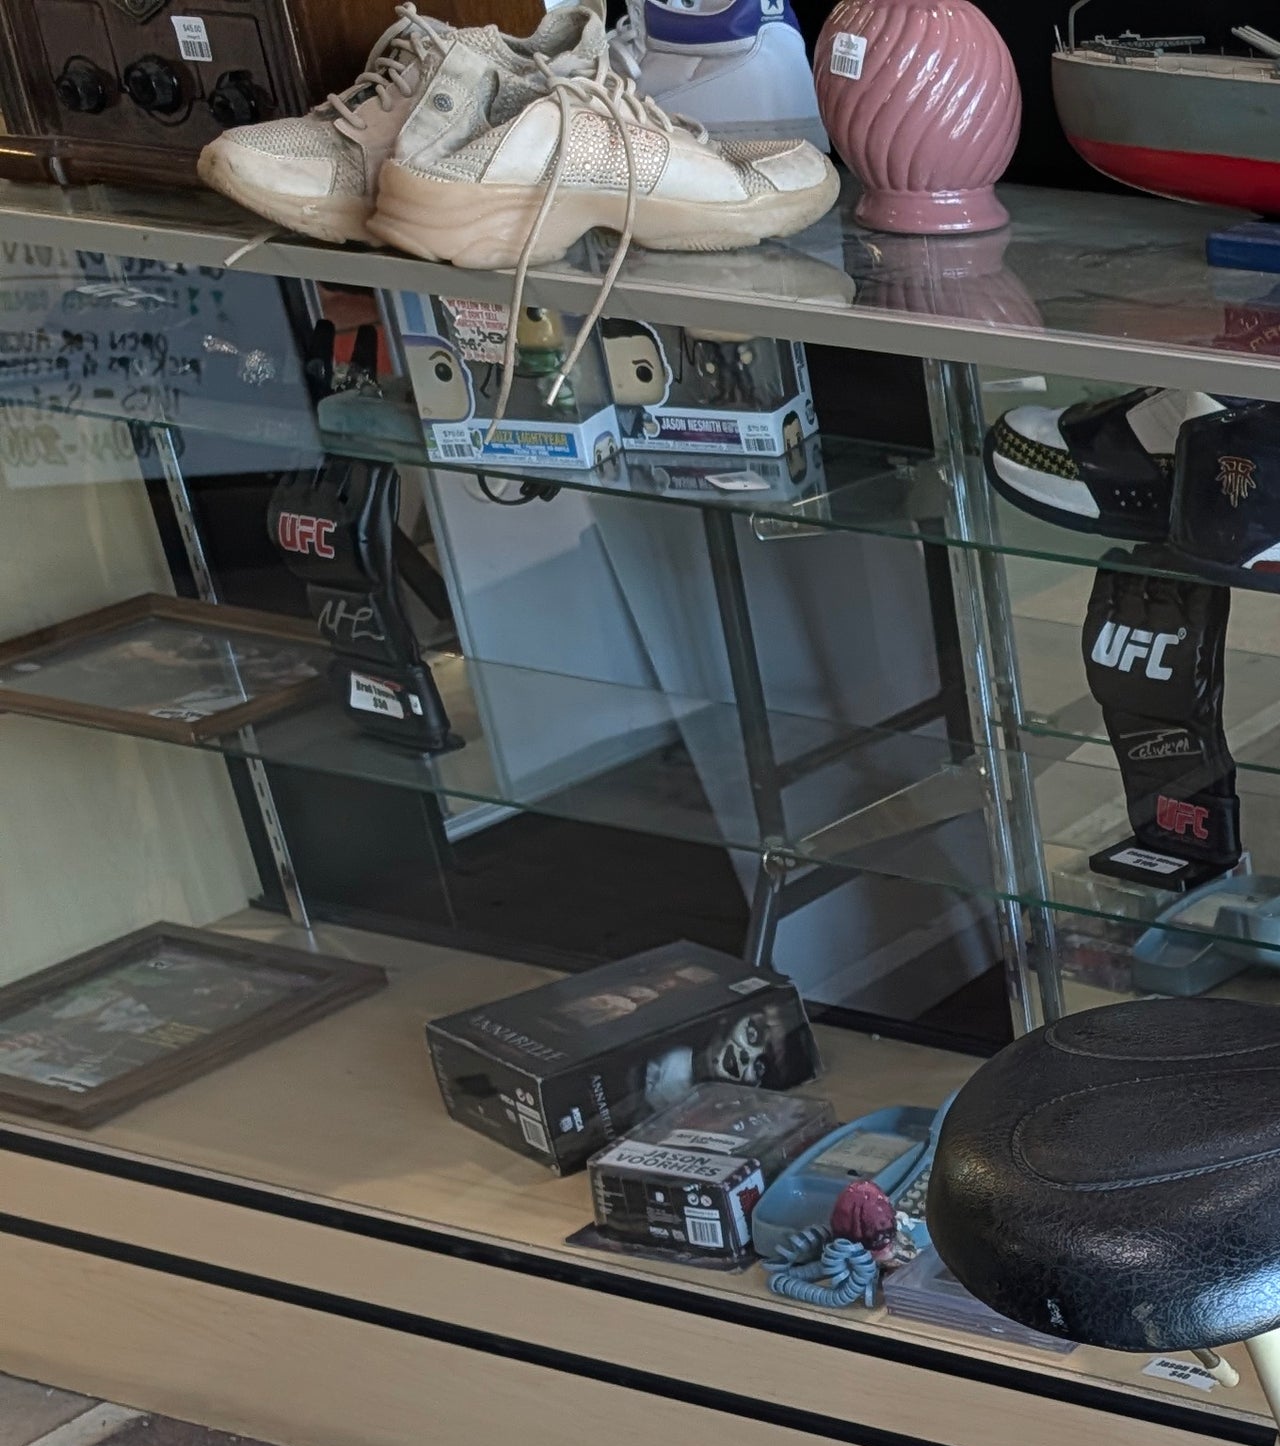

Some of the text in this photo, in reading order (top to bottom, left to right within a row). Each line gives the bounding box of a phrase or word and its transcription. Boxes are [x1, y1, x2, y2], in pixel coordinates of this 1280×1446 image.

[661, 416, 688, 432] JASON
[688, 418, 722, 434] NESMITH
[516, 432, 568, 447] LIGHTYEAR
[278, 511, 336, 560] UFC
[1091, 621, 1180, 681] UFC
[1156, 794, 1209, 840] UFC
[615, 1152, 722, 1177] VOORHEES
[643, 1147, 712, 1166] JASON
